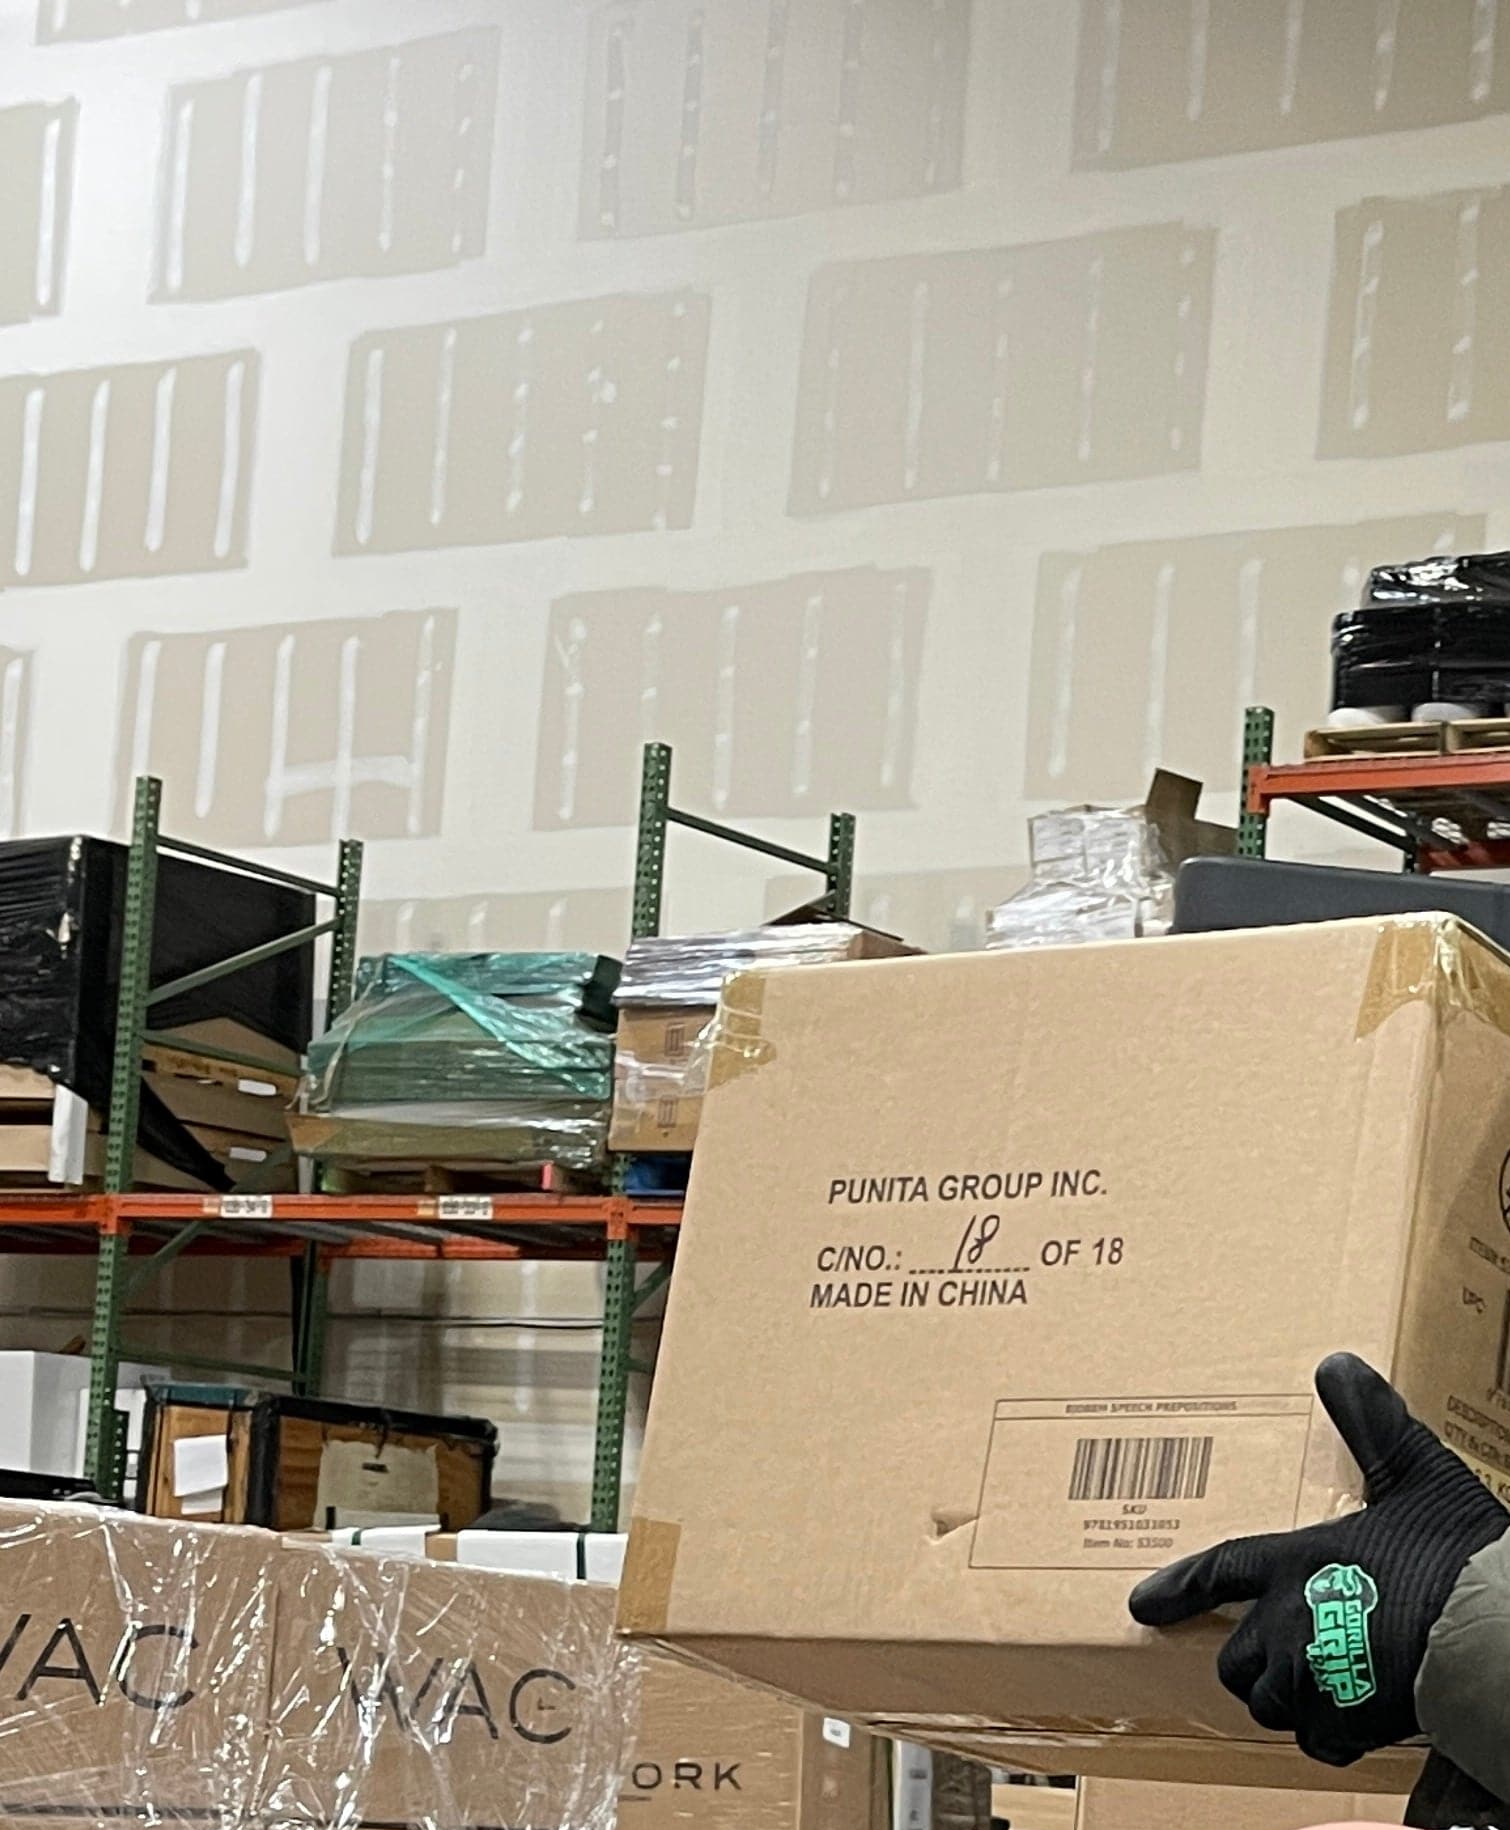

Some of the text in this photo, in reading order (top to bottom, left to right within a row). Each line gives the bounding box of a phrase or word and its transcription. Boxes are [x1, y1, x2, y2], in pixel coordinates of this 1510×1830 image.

[828, 1168, 1107, 1204] PUNITA GROUP INC.
[817, 1245, 902, 1272] C/NO.:
[1041, 1239, 1081, 1266] OF
[1092, 1237, 1124, 1265] 18
[810, 1278, 1028, 1308] MADE IN CHINA
[0, 1614, 199, 1709] AC
[1317, 1600, 1355, 1701] GRIP
[1345, 1599, 1372, 1698] GORILLA
[336, 1645, 578, 1744] WAC
[632, 1762, 741, 1791] ORK
